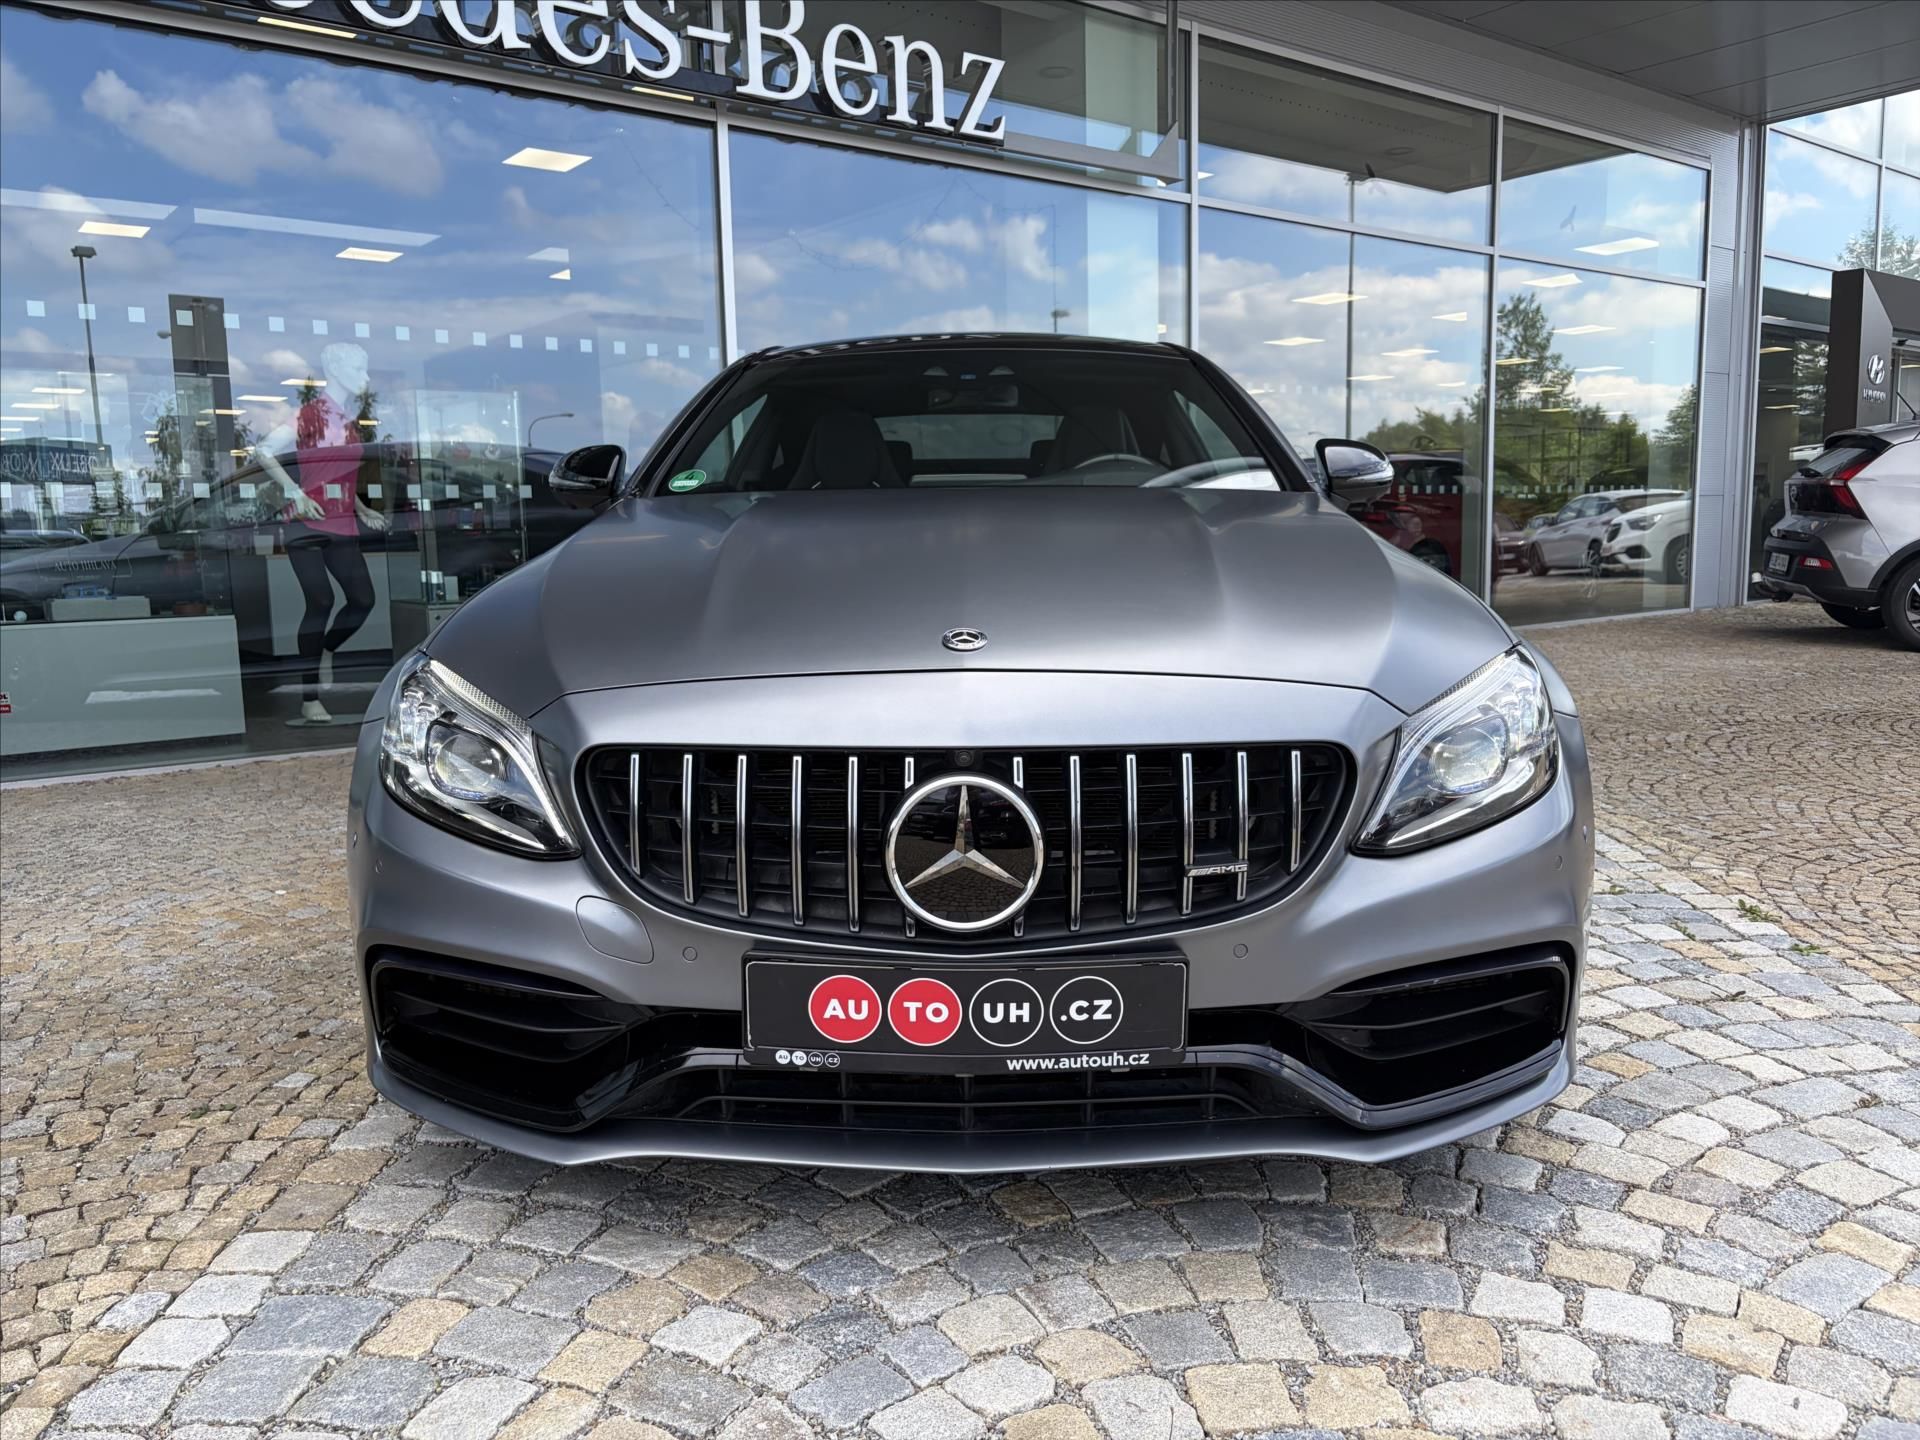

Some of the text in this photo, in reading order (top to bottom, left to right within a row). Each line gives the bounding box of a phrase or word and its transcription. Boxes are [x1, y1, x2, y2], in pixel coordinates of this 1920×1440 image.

[1207, 864, 1248, 875] AMG
[823, 998, 869, 1020] AU
[903, 1001, 949, 1023] TO
[983, 1002, 1030, 1023] UH
[1006, 1051, 1150, 1071] www.autouh.cz
